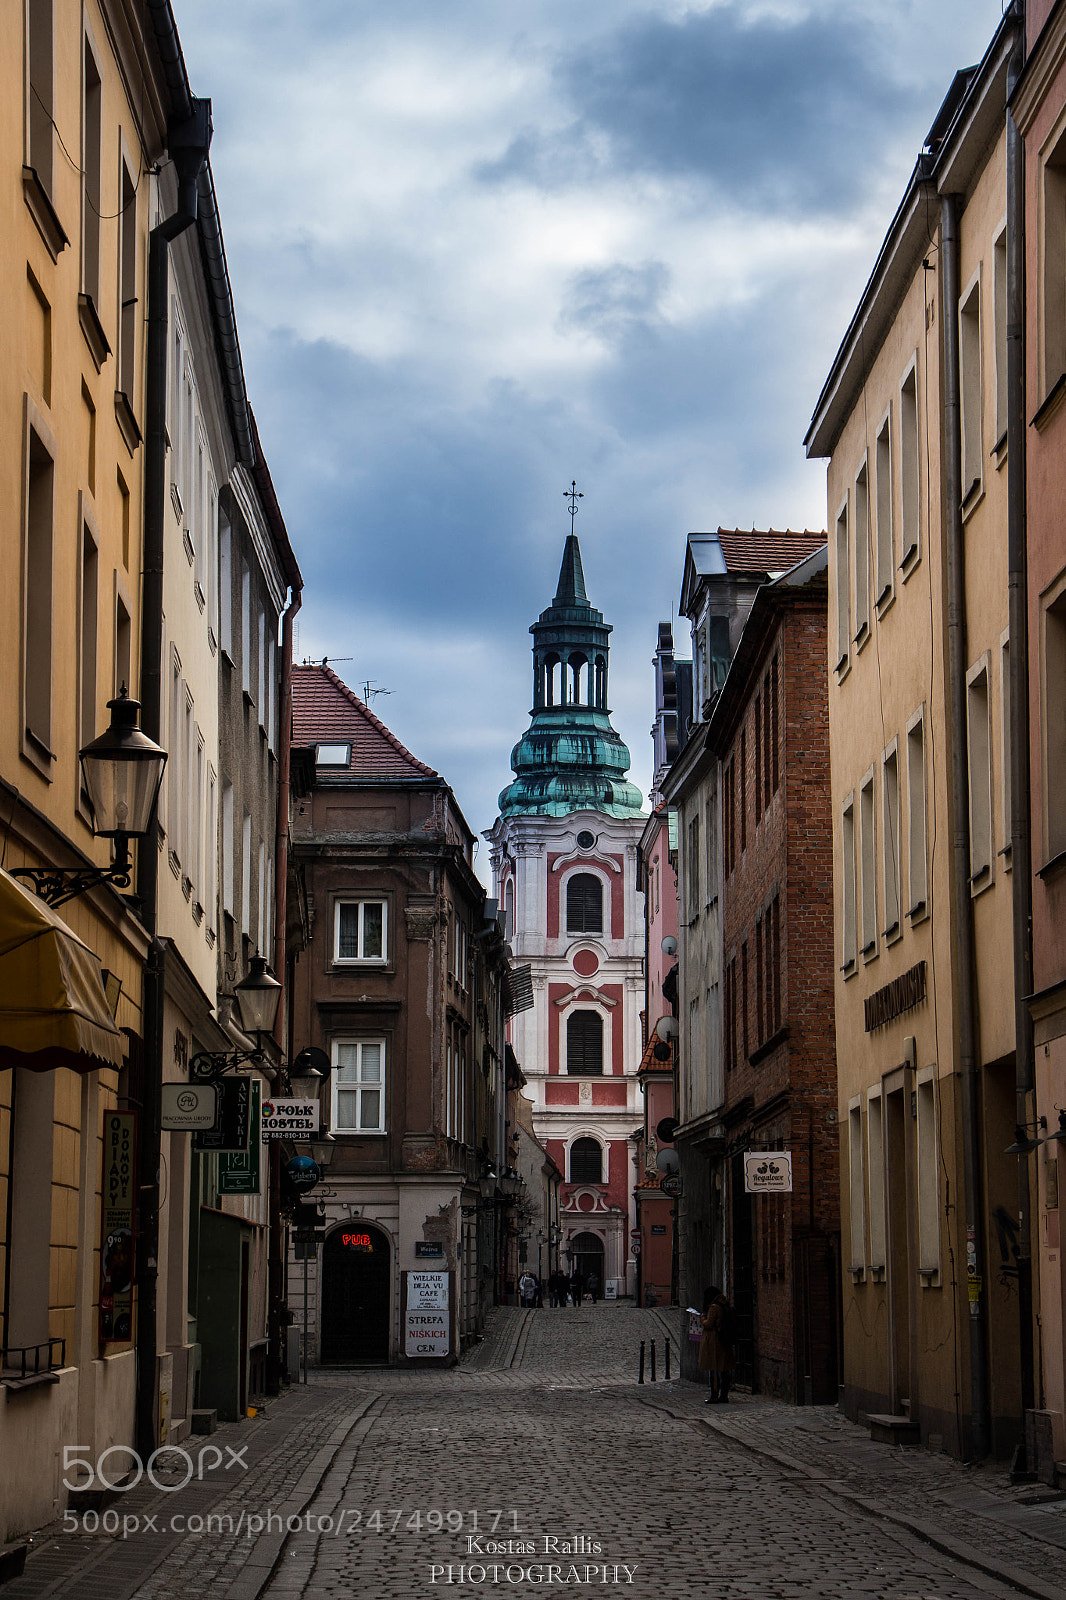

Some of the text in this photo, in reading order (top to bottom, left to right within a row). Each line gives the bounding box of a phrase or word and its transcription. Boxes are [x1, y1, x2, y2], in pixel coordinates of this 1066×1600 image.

[237, 1082, 248, 1146] ANTYKI
[276, 1105, 314, 1116] FOLK
[261, 1118, 314, 1129] HOSTEL
[109, 1117, 121, 1206] OBIADY
[120, 1128, 130, 1198] DOMOWE
[752, 1174, 784, 1182] Rogalowe
[342, 1234, 371, 1246] PUB
[408, 1316, 444, 1324] STREFA
[408, 1330, 446, 1338] NISKICH
[416, 1344, 436, 1353] CEN
